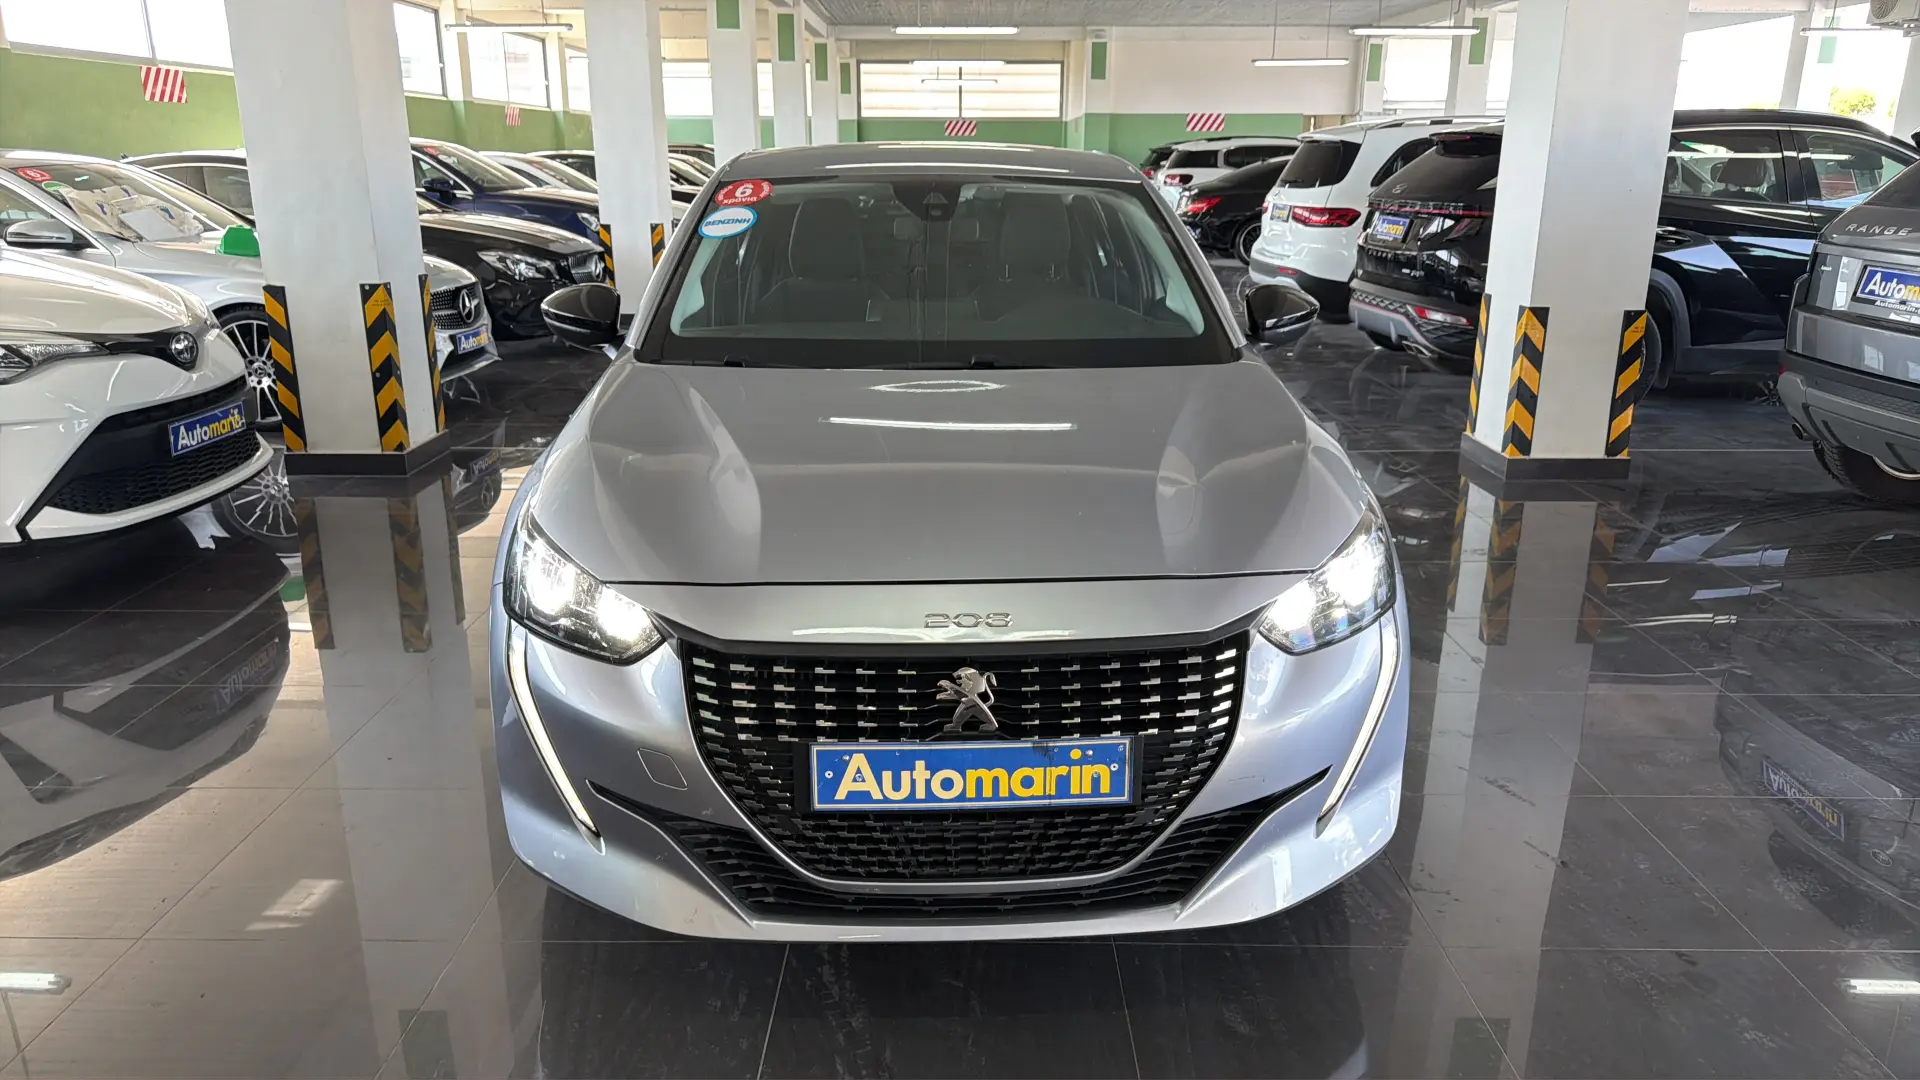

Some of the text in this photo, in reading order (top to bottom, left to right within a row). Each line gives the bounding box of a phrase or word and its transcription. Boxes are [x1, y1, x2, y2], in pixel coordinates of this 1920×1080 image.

[735, 184, 754, 198] 6
[1845, 223, 1912, 236] RANGE
[1874, 299, 1920, 314] Automarin.
[924, 612, 1014, 628] 208
[834, 748, 1111, 801] Automarin
